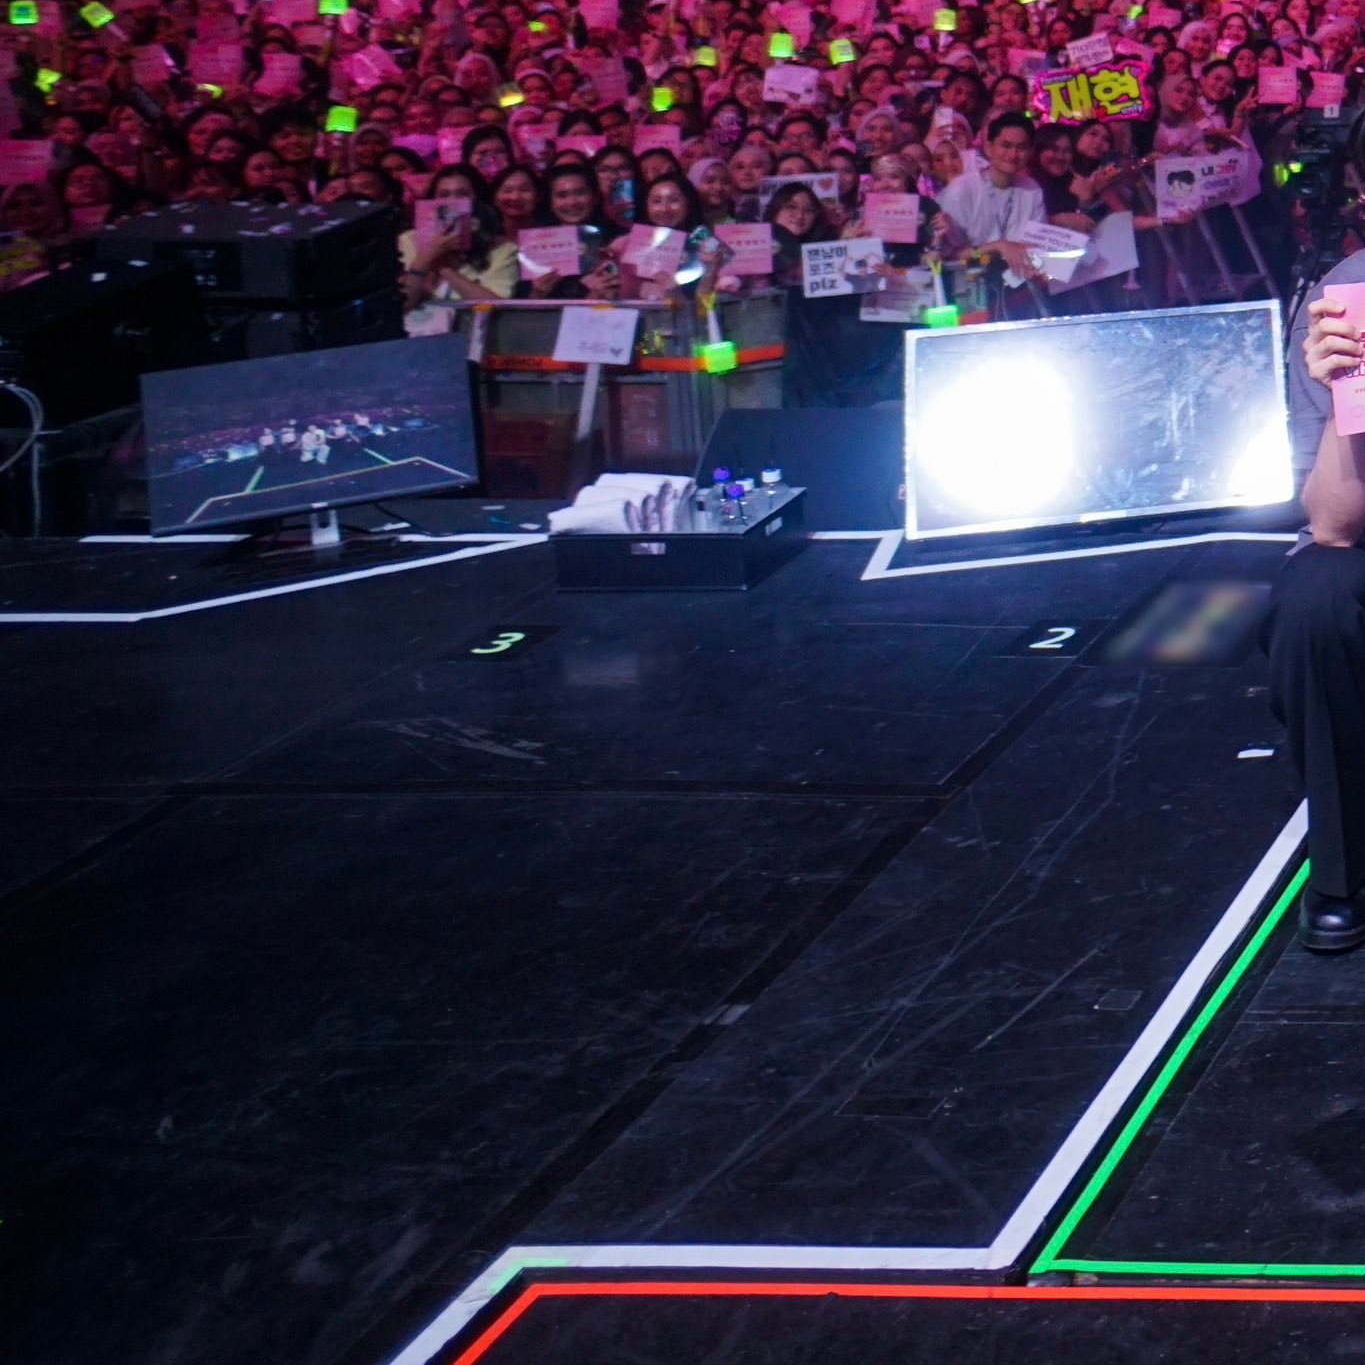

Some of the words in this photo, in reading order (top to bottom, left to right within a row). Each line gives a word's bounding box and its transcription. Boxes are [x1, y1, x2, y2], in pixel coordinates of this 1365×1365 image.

[1042, 66, 1142, 122] 재현
[471, 632, 525, 654] 3
[1029, 627, 1076, 649] 2
